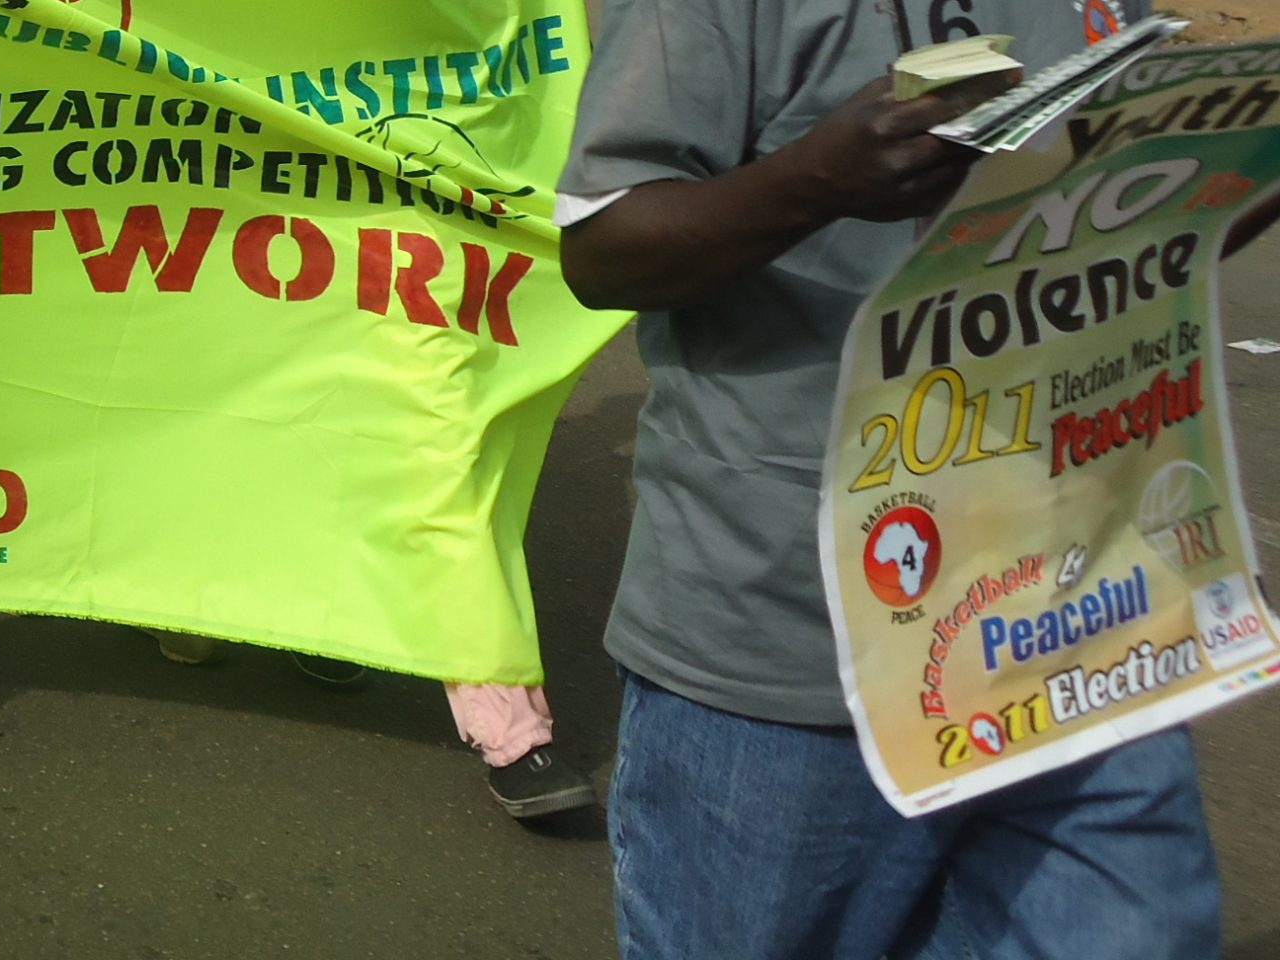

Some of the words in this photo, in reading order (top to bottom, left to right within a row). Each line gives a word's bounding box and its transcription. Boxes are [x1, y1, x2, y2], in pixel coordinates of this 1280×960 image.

[984, 157, 1202, 267] NO
[880, 231, 1201, 381] Violence
[1050, 354, 1125, 410] Election
[1130, 335, 1172, 379] Must
[1177, 320, 1202, 357] Be
[848, 365, 1043, 492] 2011
[1049, 356, 1205, 479] Peaceful
[901, 545, 917, 571] 4
[1173, 512, 1228, 568] IRI
[890, 604, 926, 625] PEACE
[920, 552, 1046, 721] Basketball
[980, 563, 1150, 672] Peaceful
[1200, 613, 1261, 649] USAID
[1045, 636, 1202, 725] Election
